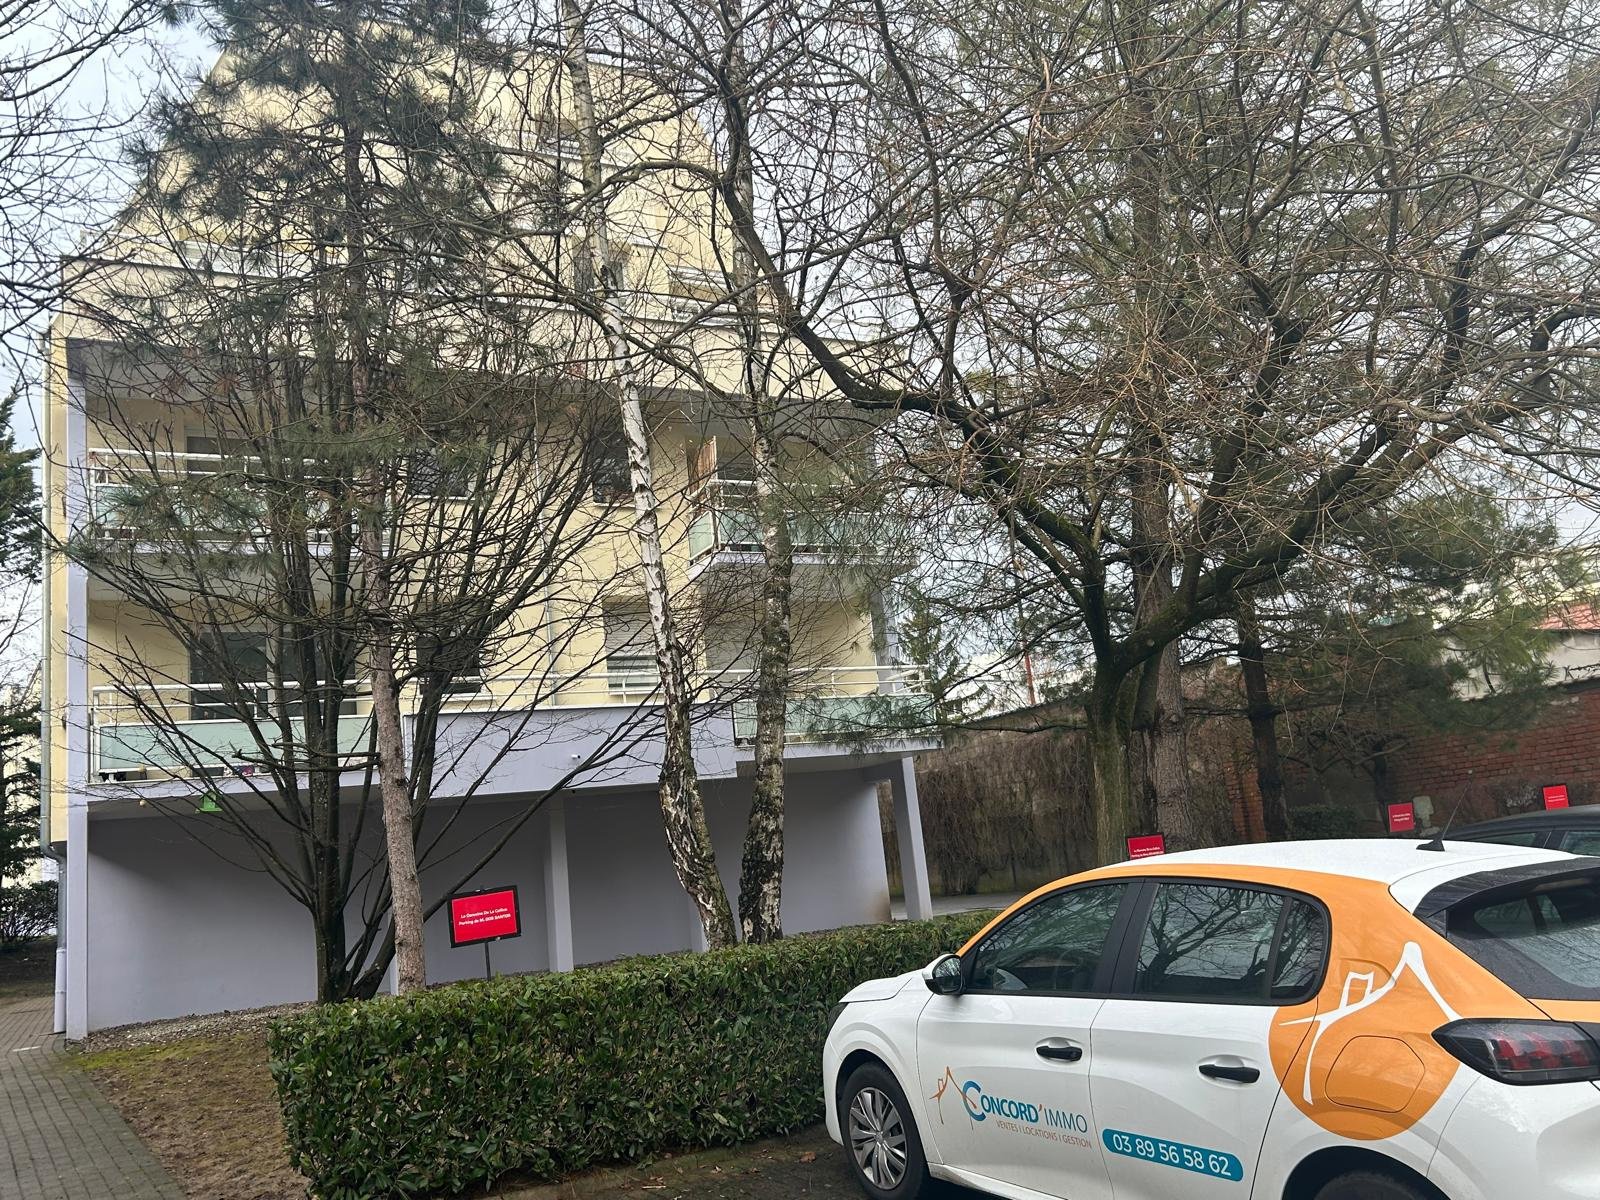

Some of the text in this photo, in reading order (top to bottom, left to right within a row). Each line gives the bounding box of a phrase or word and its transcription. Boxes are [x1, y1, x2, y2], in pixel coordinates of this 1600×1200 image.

[996, 1119, 1019, 1133] VENTES
[1022, 1126, 1058, 1142] LOCATIONS
[1062, 1134, 1093, 1149] GESTION
[1112, 1133, 1232, 1176] 03 89 56 58 62
